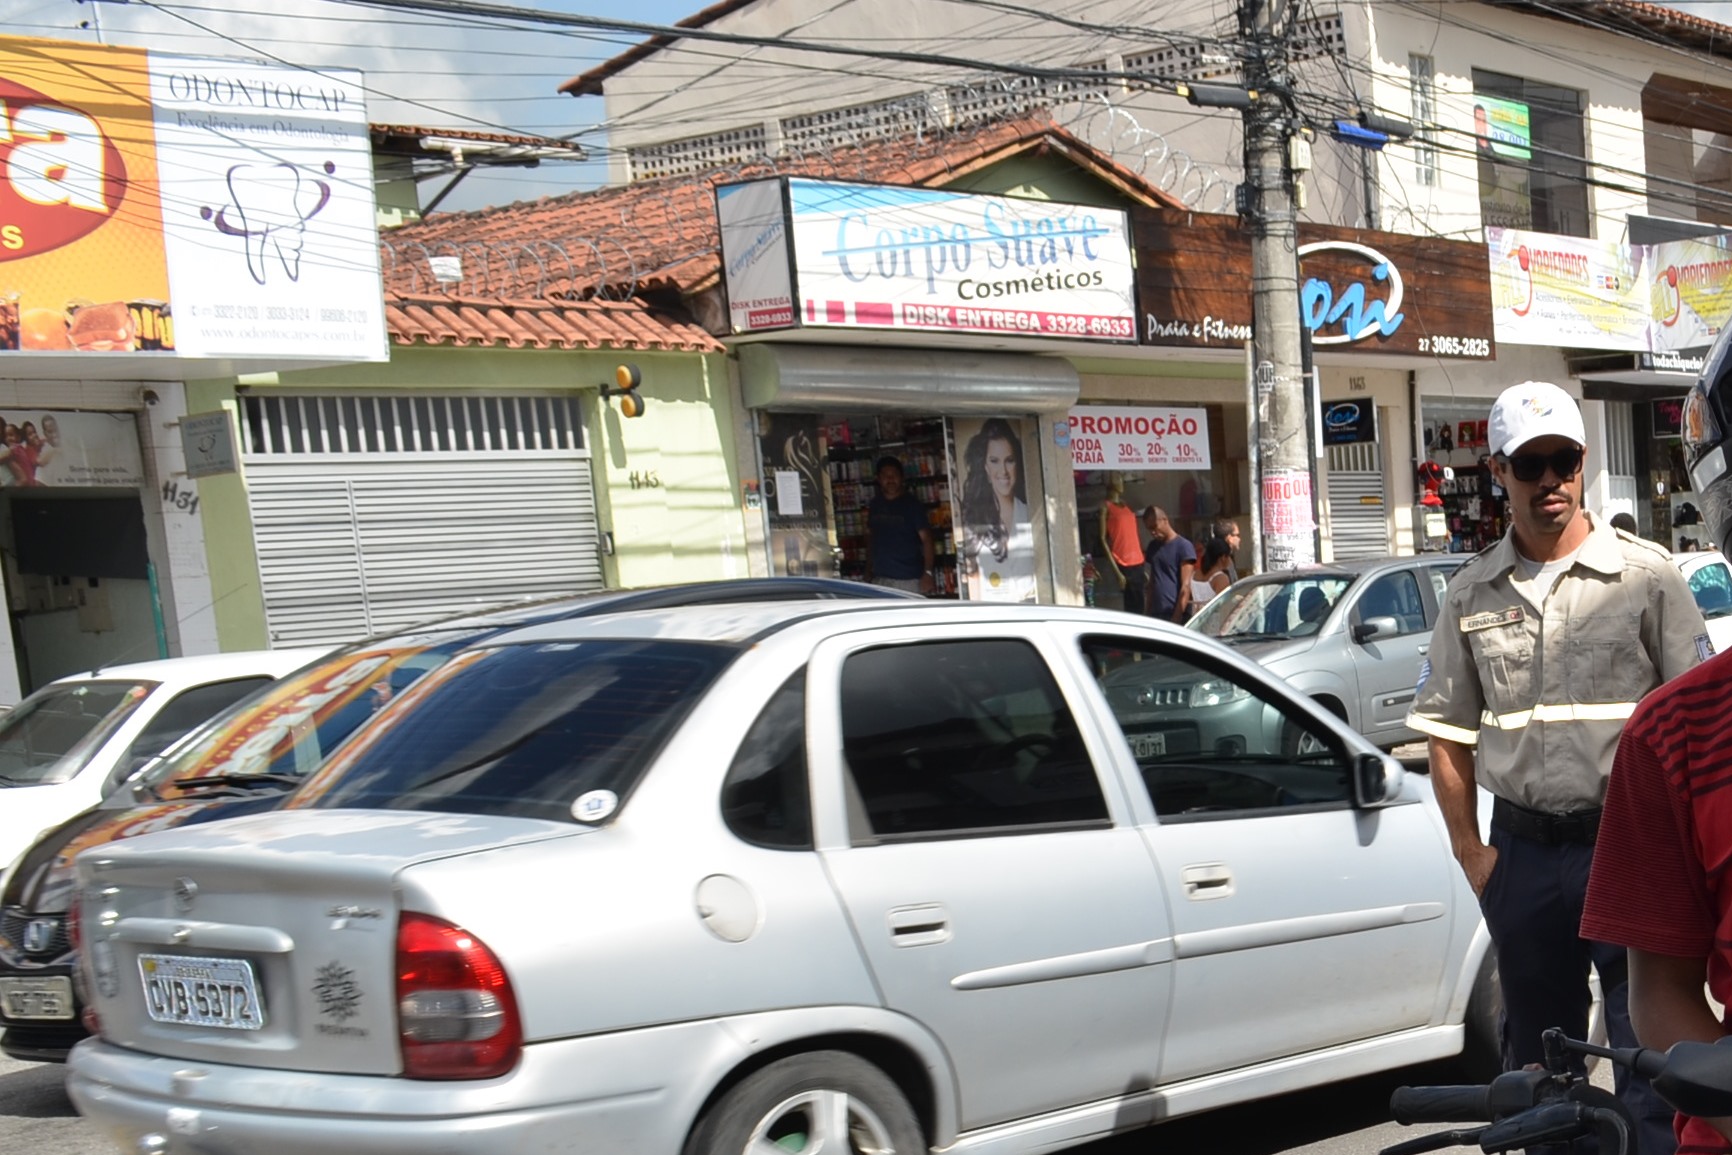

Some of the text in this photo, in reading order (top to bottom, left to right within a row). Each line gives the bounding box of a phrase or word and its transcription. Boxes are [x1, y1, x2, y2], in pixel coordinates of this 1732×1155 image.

[169, 72, 347, 113] ODONTOCAP
[176, 112, 350, 145] Excelência em Odontologia
[836, 200, 1100, 296] Corpo Suave
[957, 268, 1103, 302] Cosméticos
[752, 296, 790, 308] ENTREGA
[904, 304, 1131, 336] DISK ENTREGA 3328-6933
[1146, 312, 1253, 343] Praia e Fitness
[1418, 336, 1491, 357] 27 3065-2825
[1067, 413, 1198, 440] PROMOÇÃO
[1072, 452, 1105, 464] RAIA
[150, 978, 254, 1020] CVB-5372
